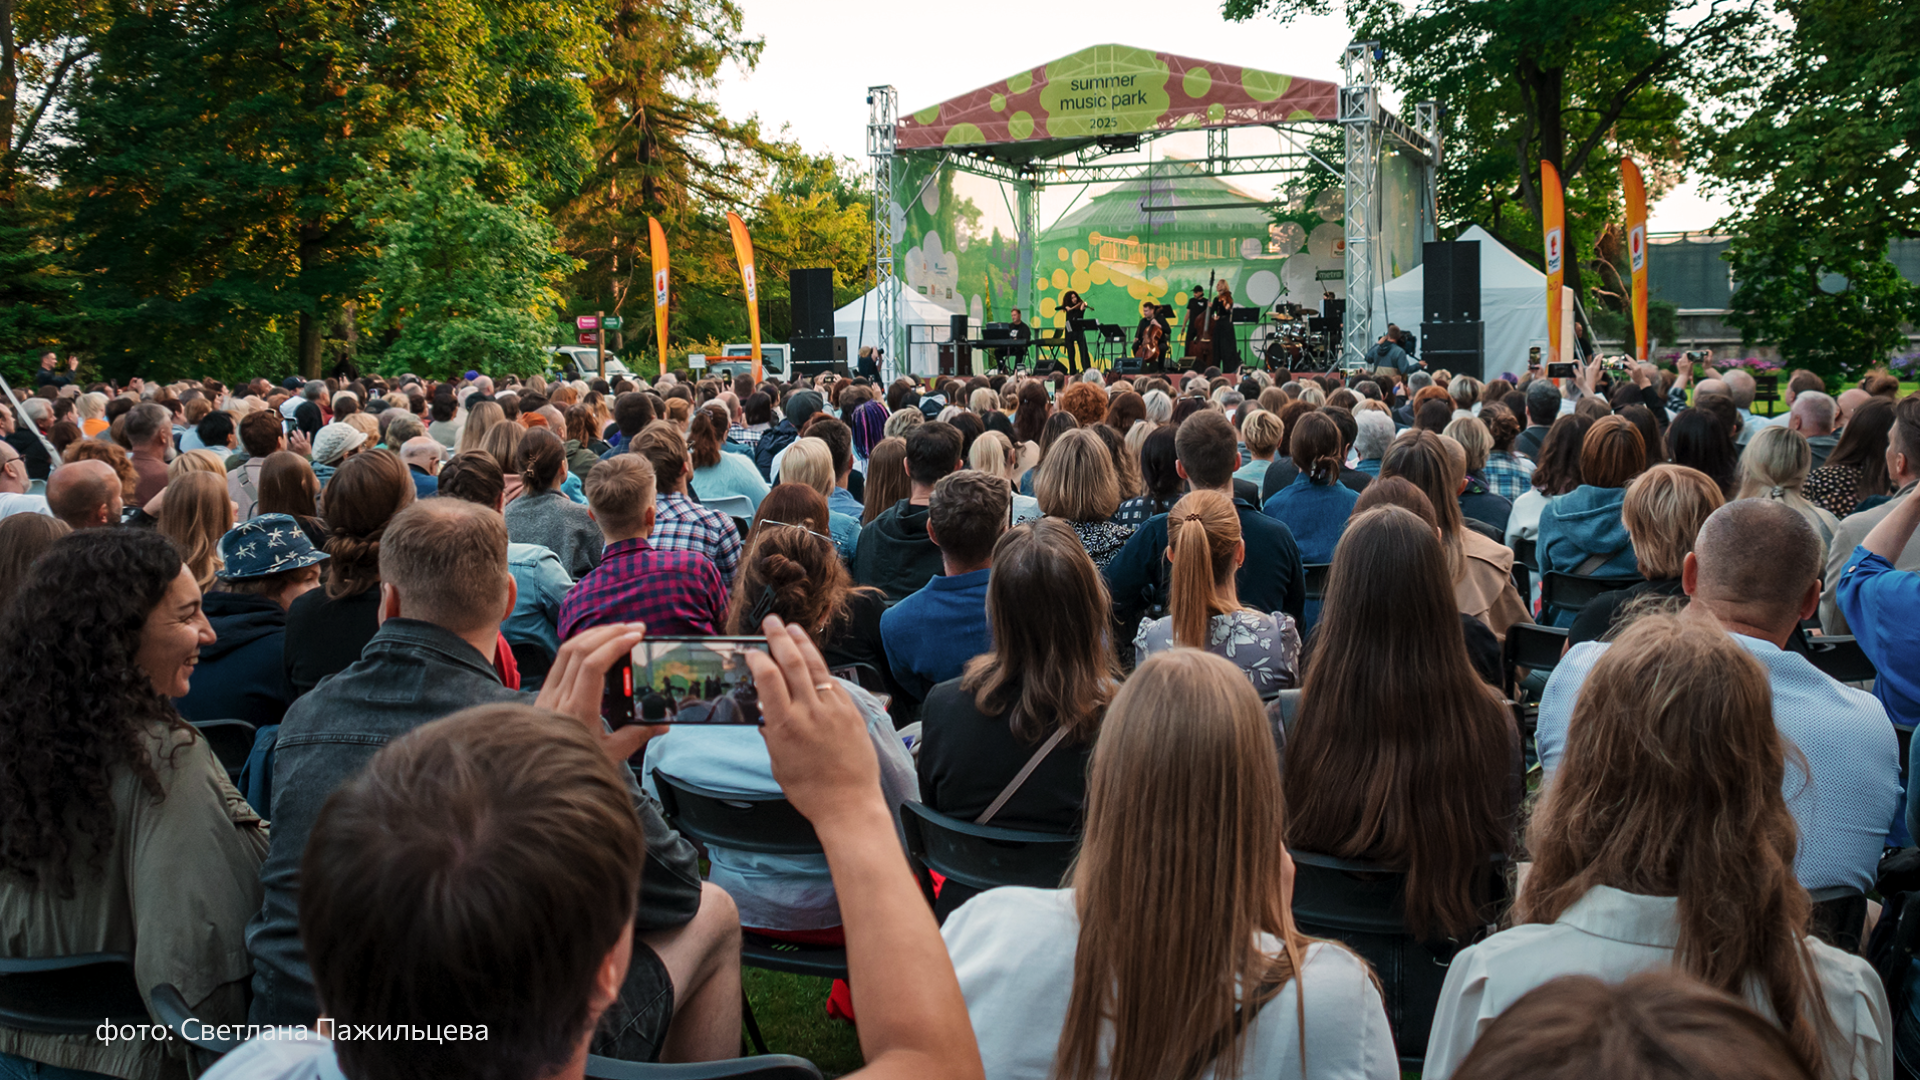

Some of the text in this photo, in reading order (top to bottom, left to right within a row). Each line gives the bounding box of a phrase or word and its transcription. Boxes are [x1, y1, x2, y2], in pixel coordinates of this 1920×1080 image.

[1071, 75, 1137, 91] summer
[1060, 89, 1147, 111] music park
[1090, 117, 1118, 129] 2025
